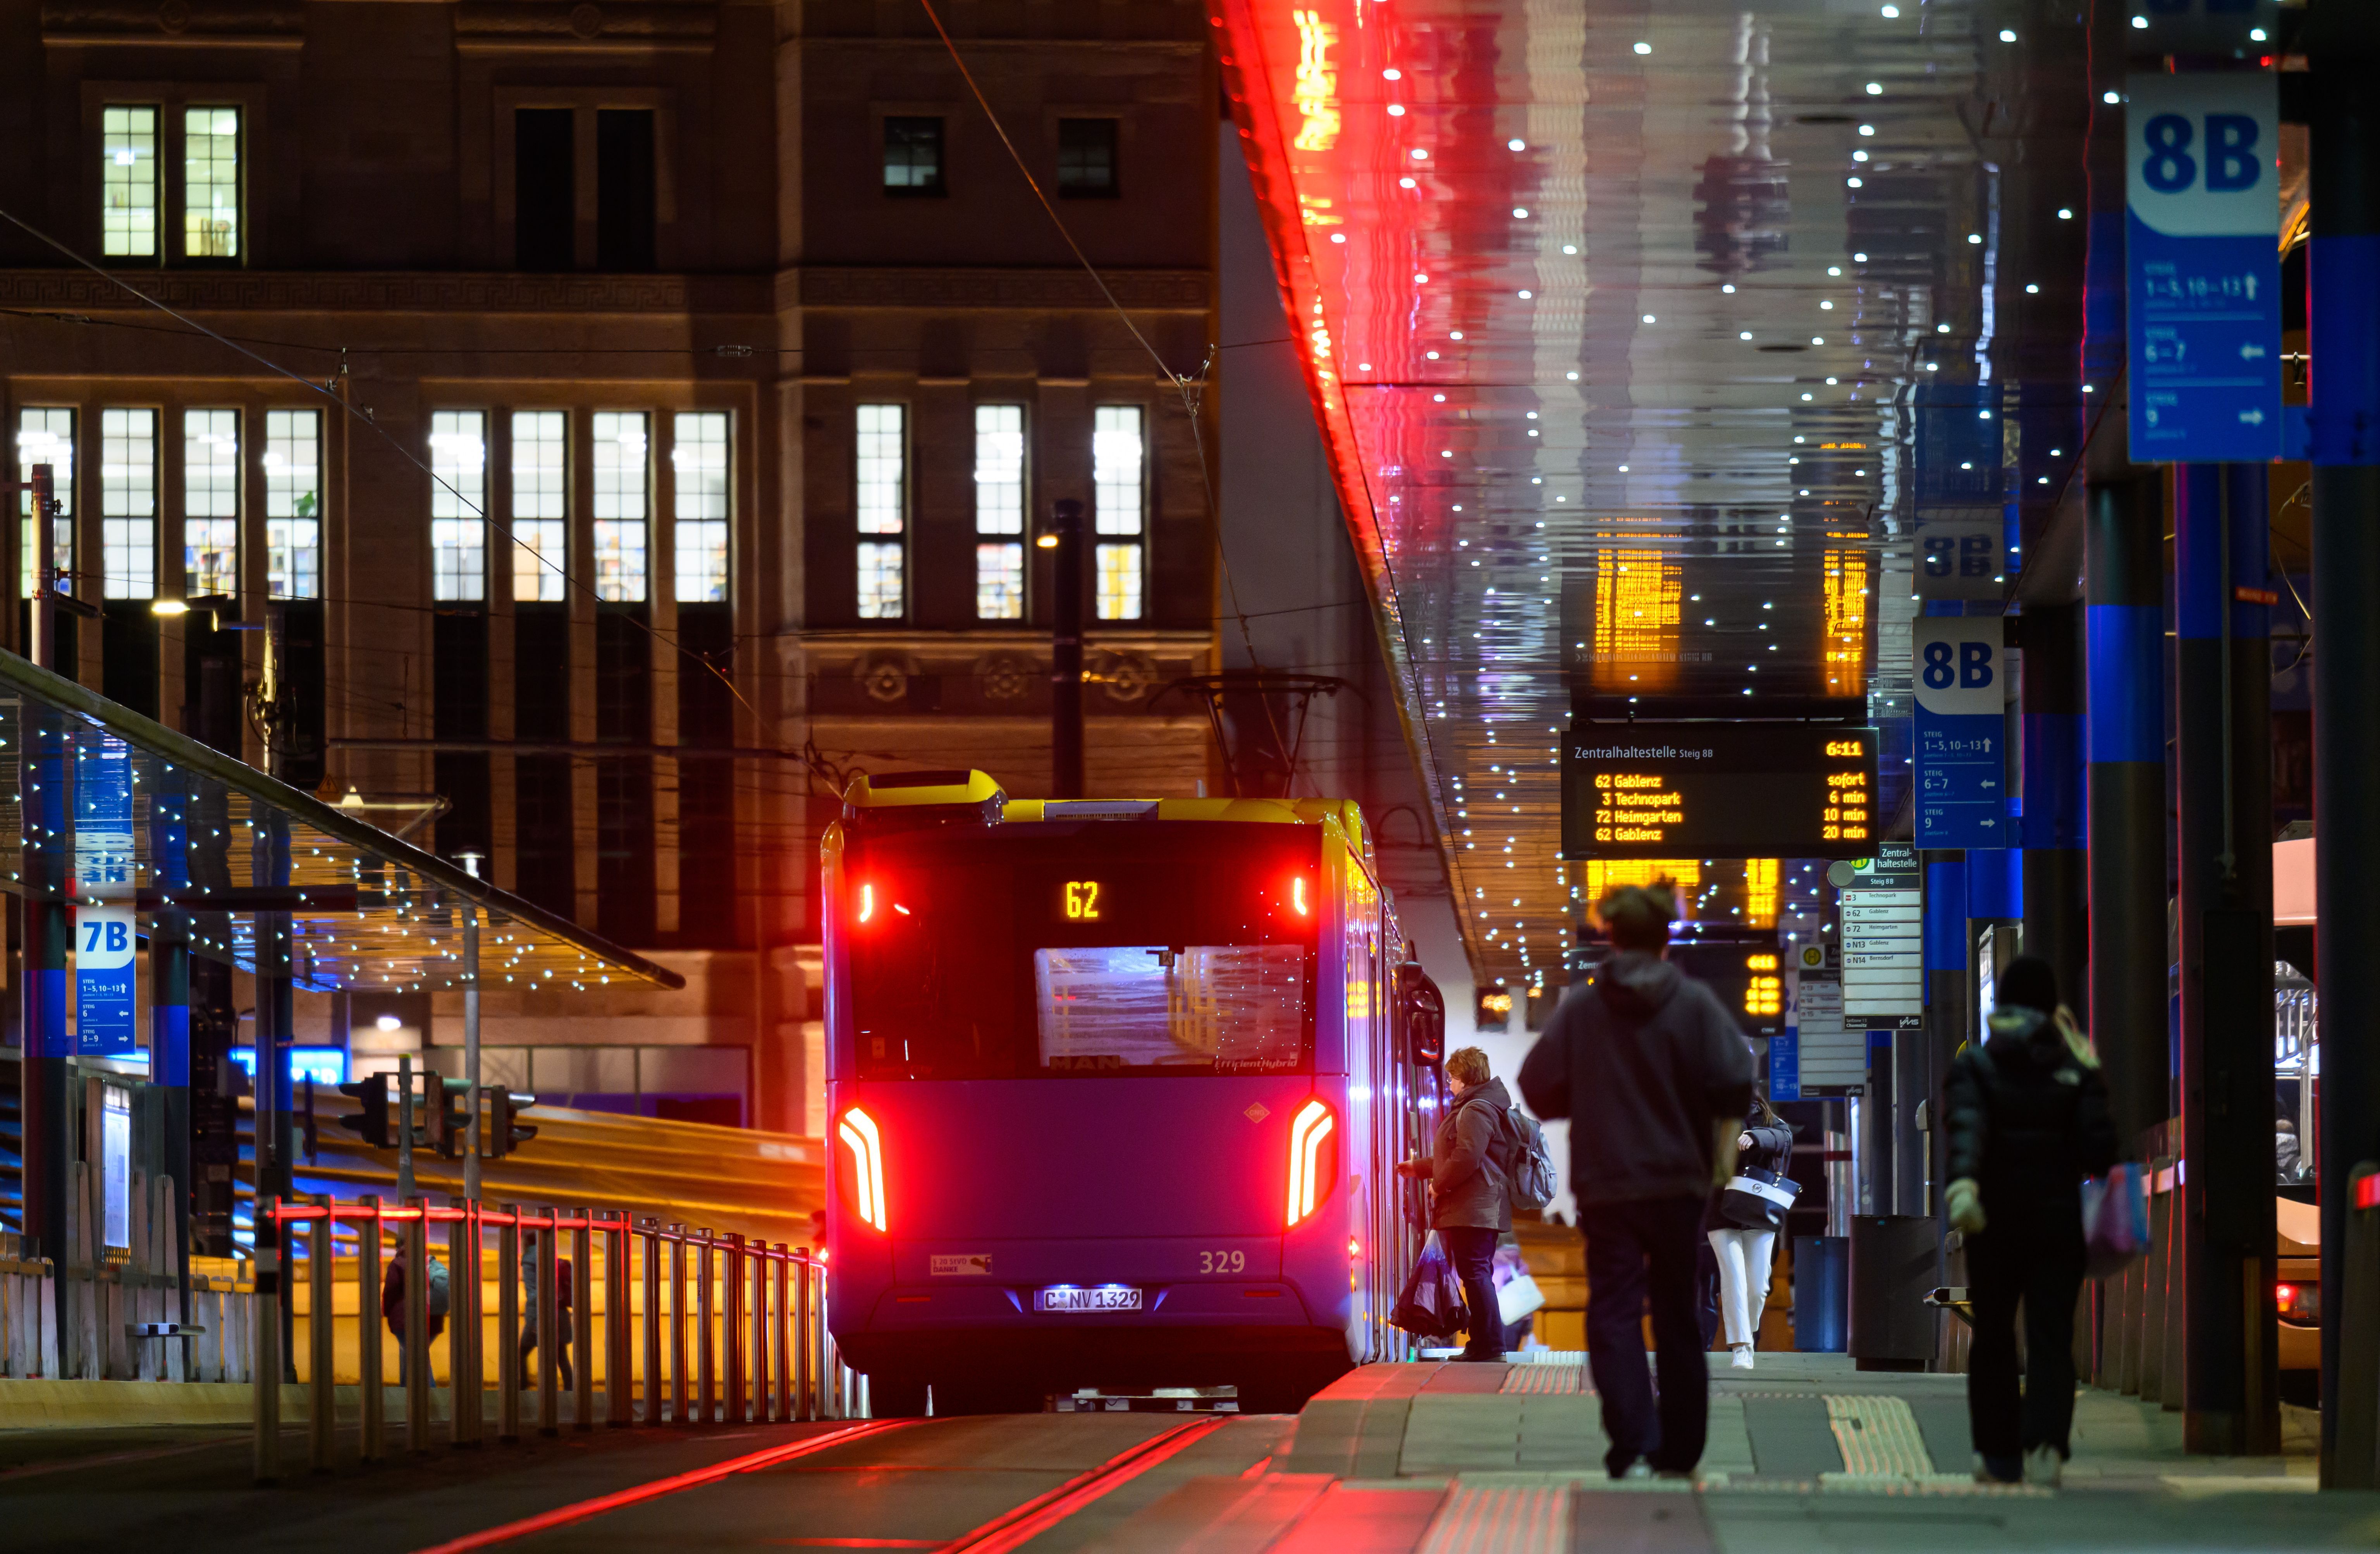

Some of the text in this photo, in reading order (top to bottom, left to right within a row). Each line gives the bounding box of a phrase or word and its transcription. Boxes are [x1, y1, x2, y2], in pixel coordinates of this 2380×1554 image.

[2143, 113, 2261, 193] 8B
[1923, 641, 1993, 689] 8B
[1575, 746, 1713, 760] Zentralhaltestelle Steig 8B
[1826, 741, 1862, 756] 6:11
[1925, 740, 1981, 751] 1–5, 10–13
[1596, 773, 1865, 788] 62 Gablenz sofort
[1924, 779, 1948, 789] 6–7
[1602, 791, 1865, 807] 3 Technopark 6 min
[1596, 809, 1866, 825] 72 Heimgarten 10 min
[1925, 818, 1932, 828] 9
[1596, 827, 1866, 841] 62 Gablenz 20 min
[1882, 848, 1912, 857] Zentral-
[1878, 858, 1917, 868] haltestelle
[1066, 881, 1098, 918] 62
[83, 921, 127, 952] 7B
[1900, 1017, 1919, 1028] VMS
[1049, 1055, 1298, 1069] MAN EfficientHybrid
[1200, 1250, 1245, 1274] 329
[1046, 1291, 1141, 1308] C NV 1329
